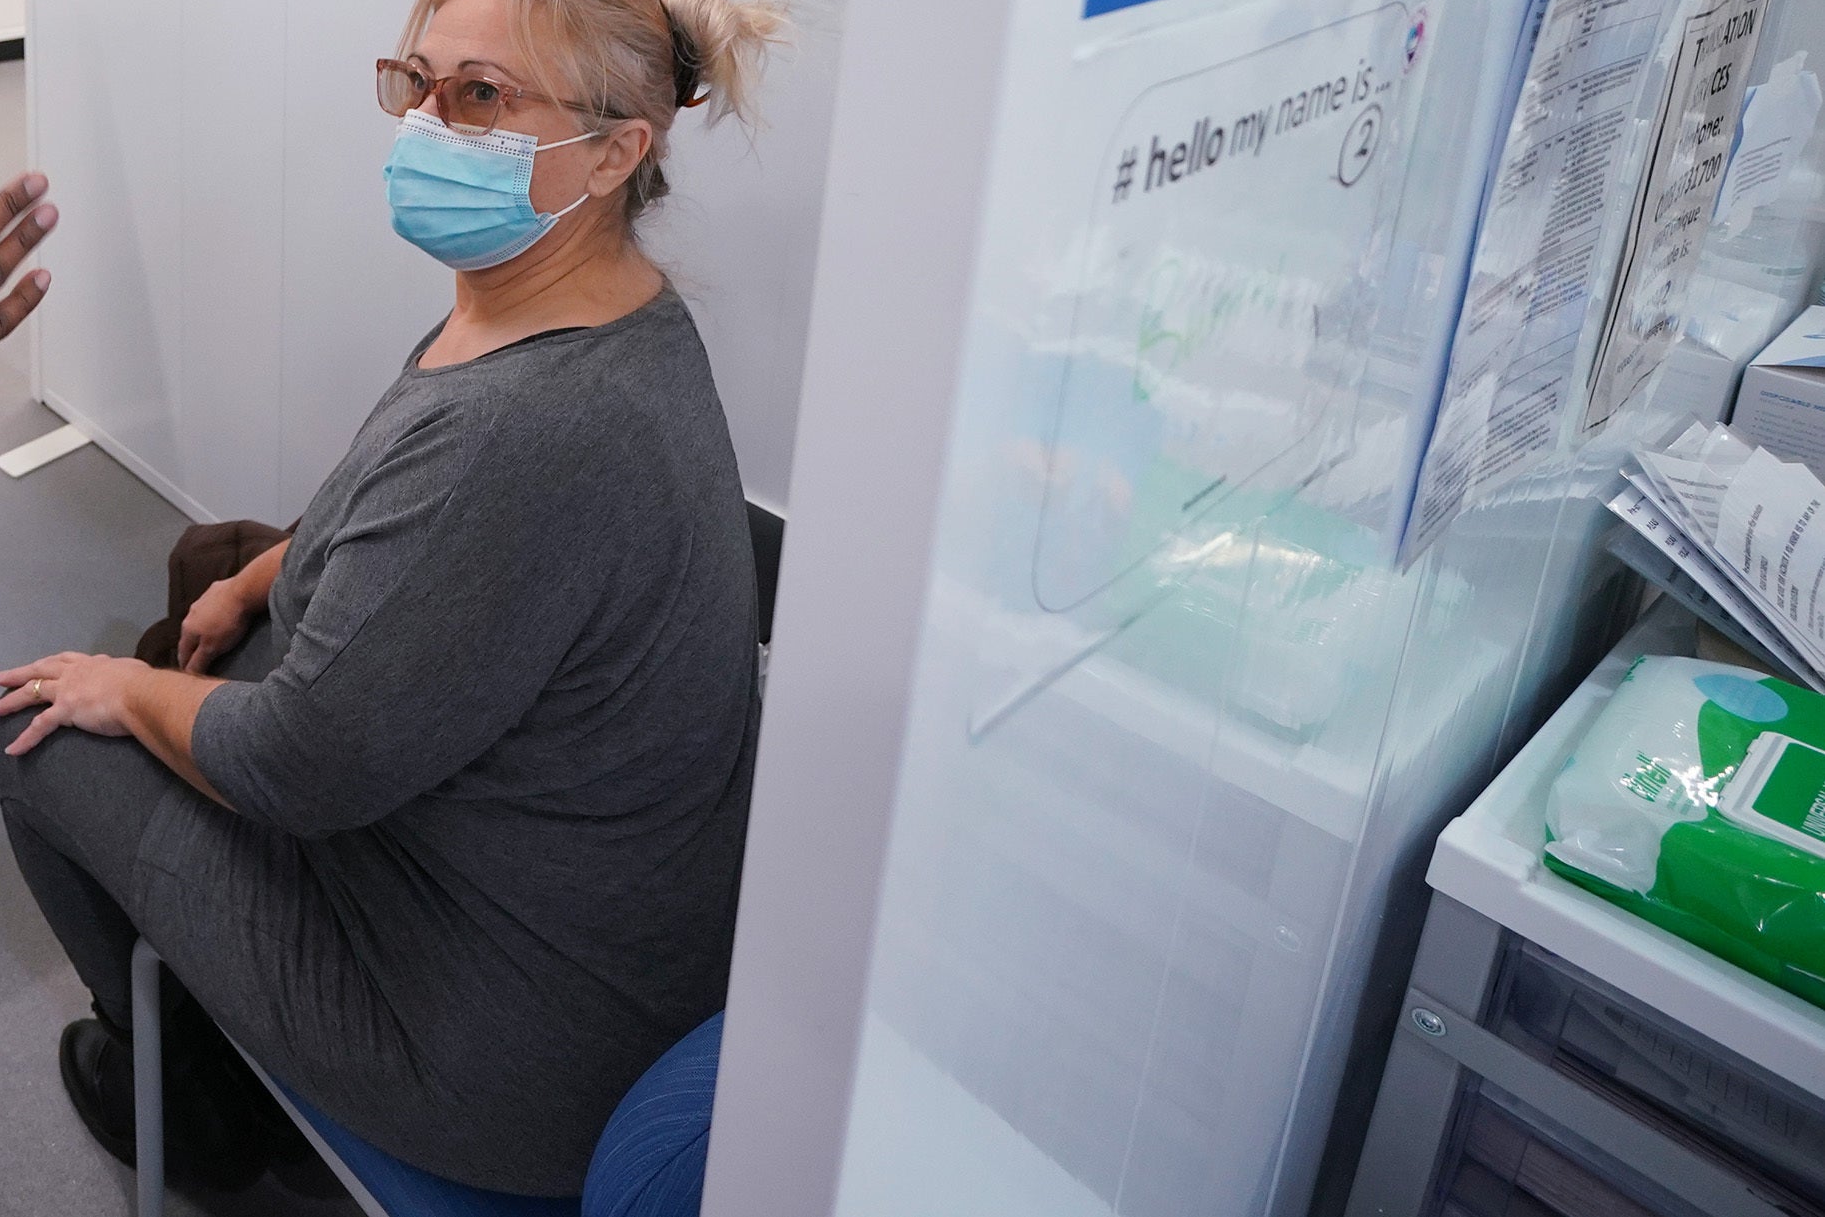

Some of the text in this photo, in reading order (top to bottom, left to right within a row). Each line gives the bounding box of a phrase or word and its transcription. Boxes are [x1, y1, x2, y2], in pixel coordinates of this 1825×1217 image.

[1143, 116, 1224, 193] hello
[1228, 104, 1273, 157] my
[1276, 75, 1346, 135] name
[1356, 118, 1374, 158] 2
